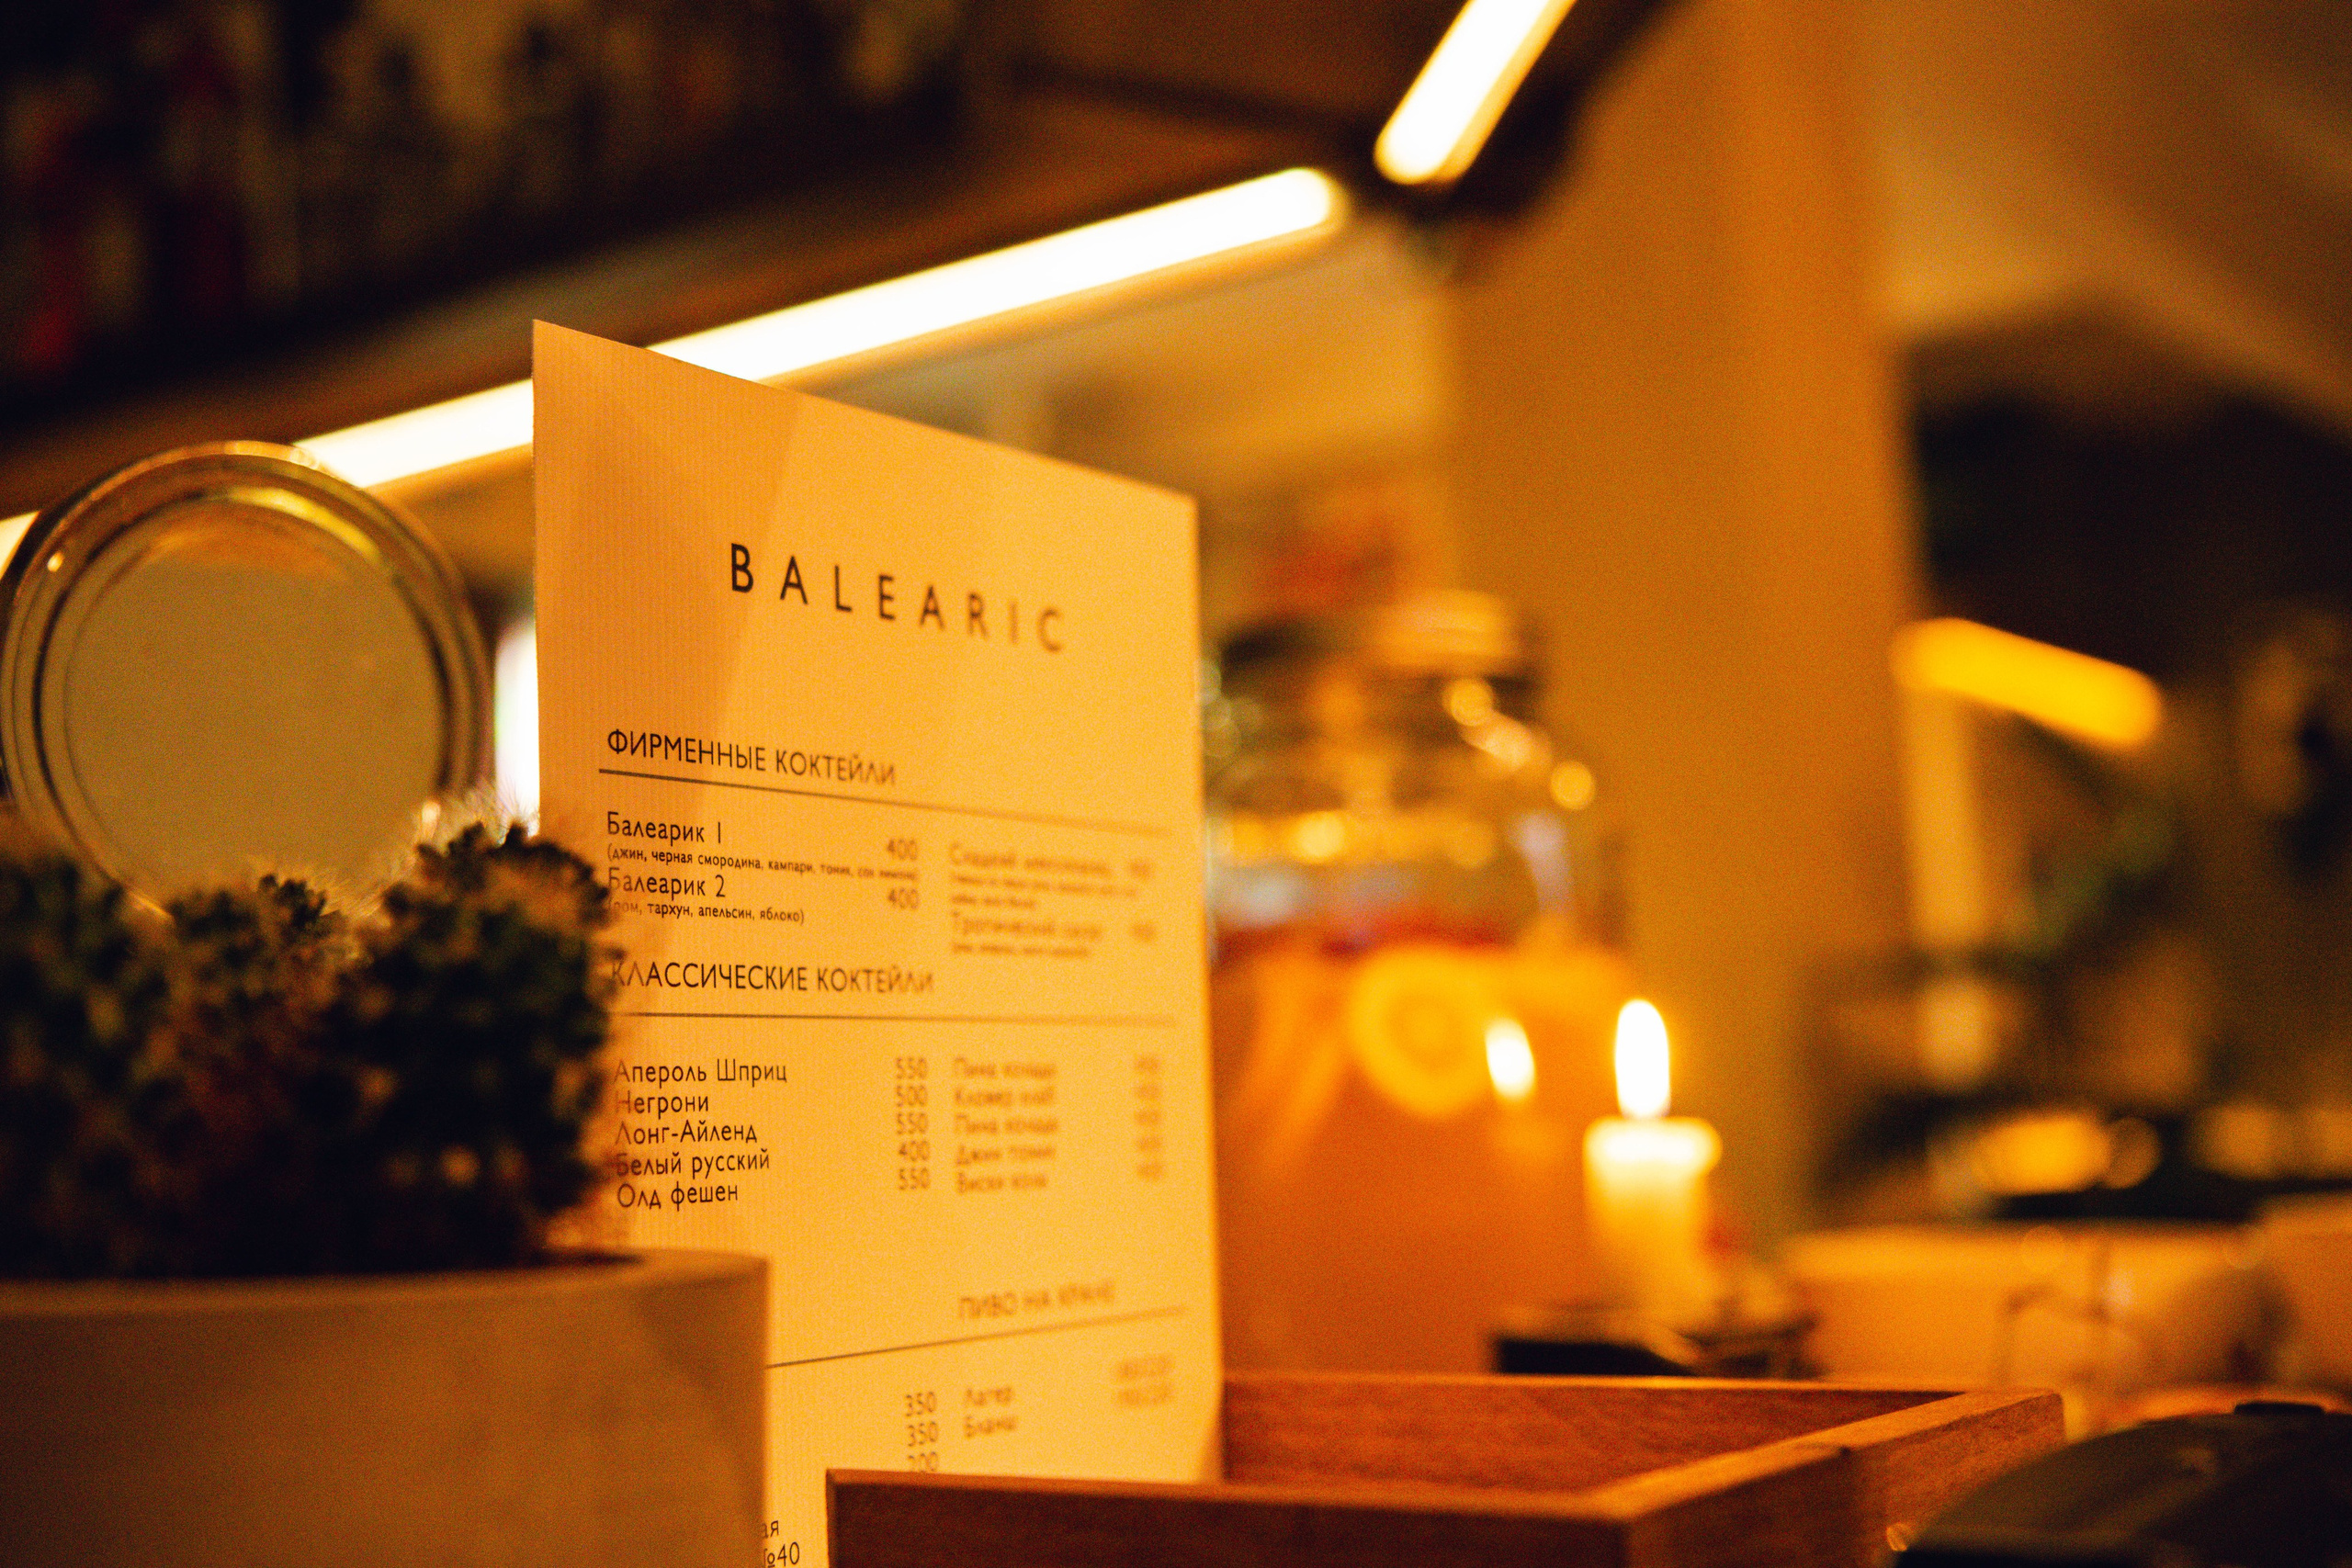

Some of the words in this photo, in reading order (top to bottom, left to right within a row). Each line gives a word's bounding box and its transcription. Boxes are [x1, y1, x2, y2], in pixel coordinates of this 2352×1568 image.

[731, 542, 1063, 654] BALEARIC
[607, 728, 766, 772] ФИРМЕННЫЕ
[775, 749, 896, 785] КОКТЕЙЛИ
[607, 811, 705, 846] Балеарик
[607, 842, 648, 863] (джин,
[651, 850, 693, 866] черная
[697, 853, 764, 872] смородина,
[886, 838, 919, 862] 400
[608, 867, 706, 901] Балеарик
[715, 874, 727, 898] 2
[887, 886, 921, 911] 400
[647, 902, 694, 919] тархун,
[698, 906, 756, 920] апельсин,
[760, 906, 805, 926] яблоко)
[612, 961, 808, 991] КЛАССИЧЕСКИЕ
[818, 965, 933, 995] КОКТЕЙЛИ
[615, 1059, 707, 1089] Апероль
[717, 1058, 787, 1089] Шприц
[896, 1057, 928, 1080] 550
[616, 1090, 709, 1120] Негрони
[896, 1084, 928, 1108] 500
[615, 1119, 758, 1145] Лонг-Айленд
[896, 1111, 929, 1135] 550
[616, 1151, 682, 1179] Белый
[692, 1147, 771, 1180] русский
[898, 1139, 930, 1163] 400
[899, 1167, 931, 1191] 550
[617, 1182, 662, 1211] Олд
[670, 1179, 739, 1212] фешен
[904, 1390, 937, 1418] 350
[906, 1419, 939, 1449] 350
